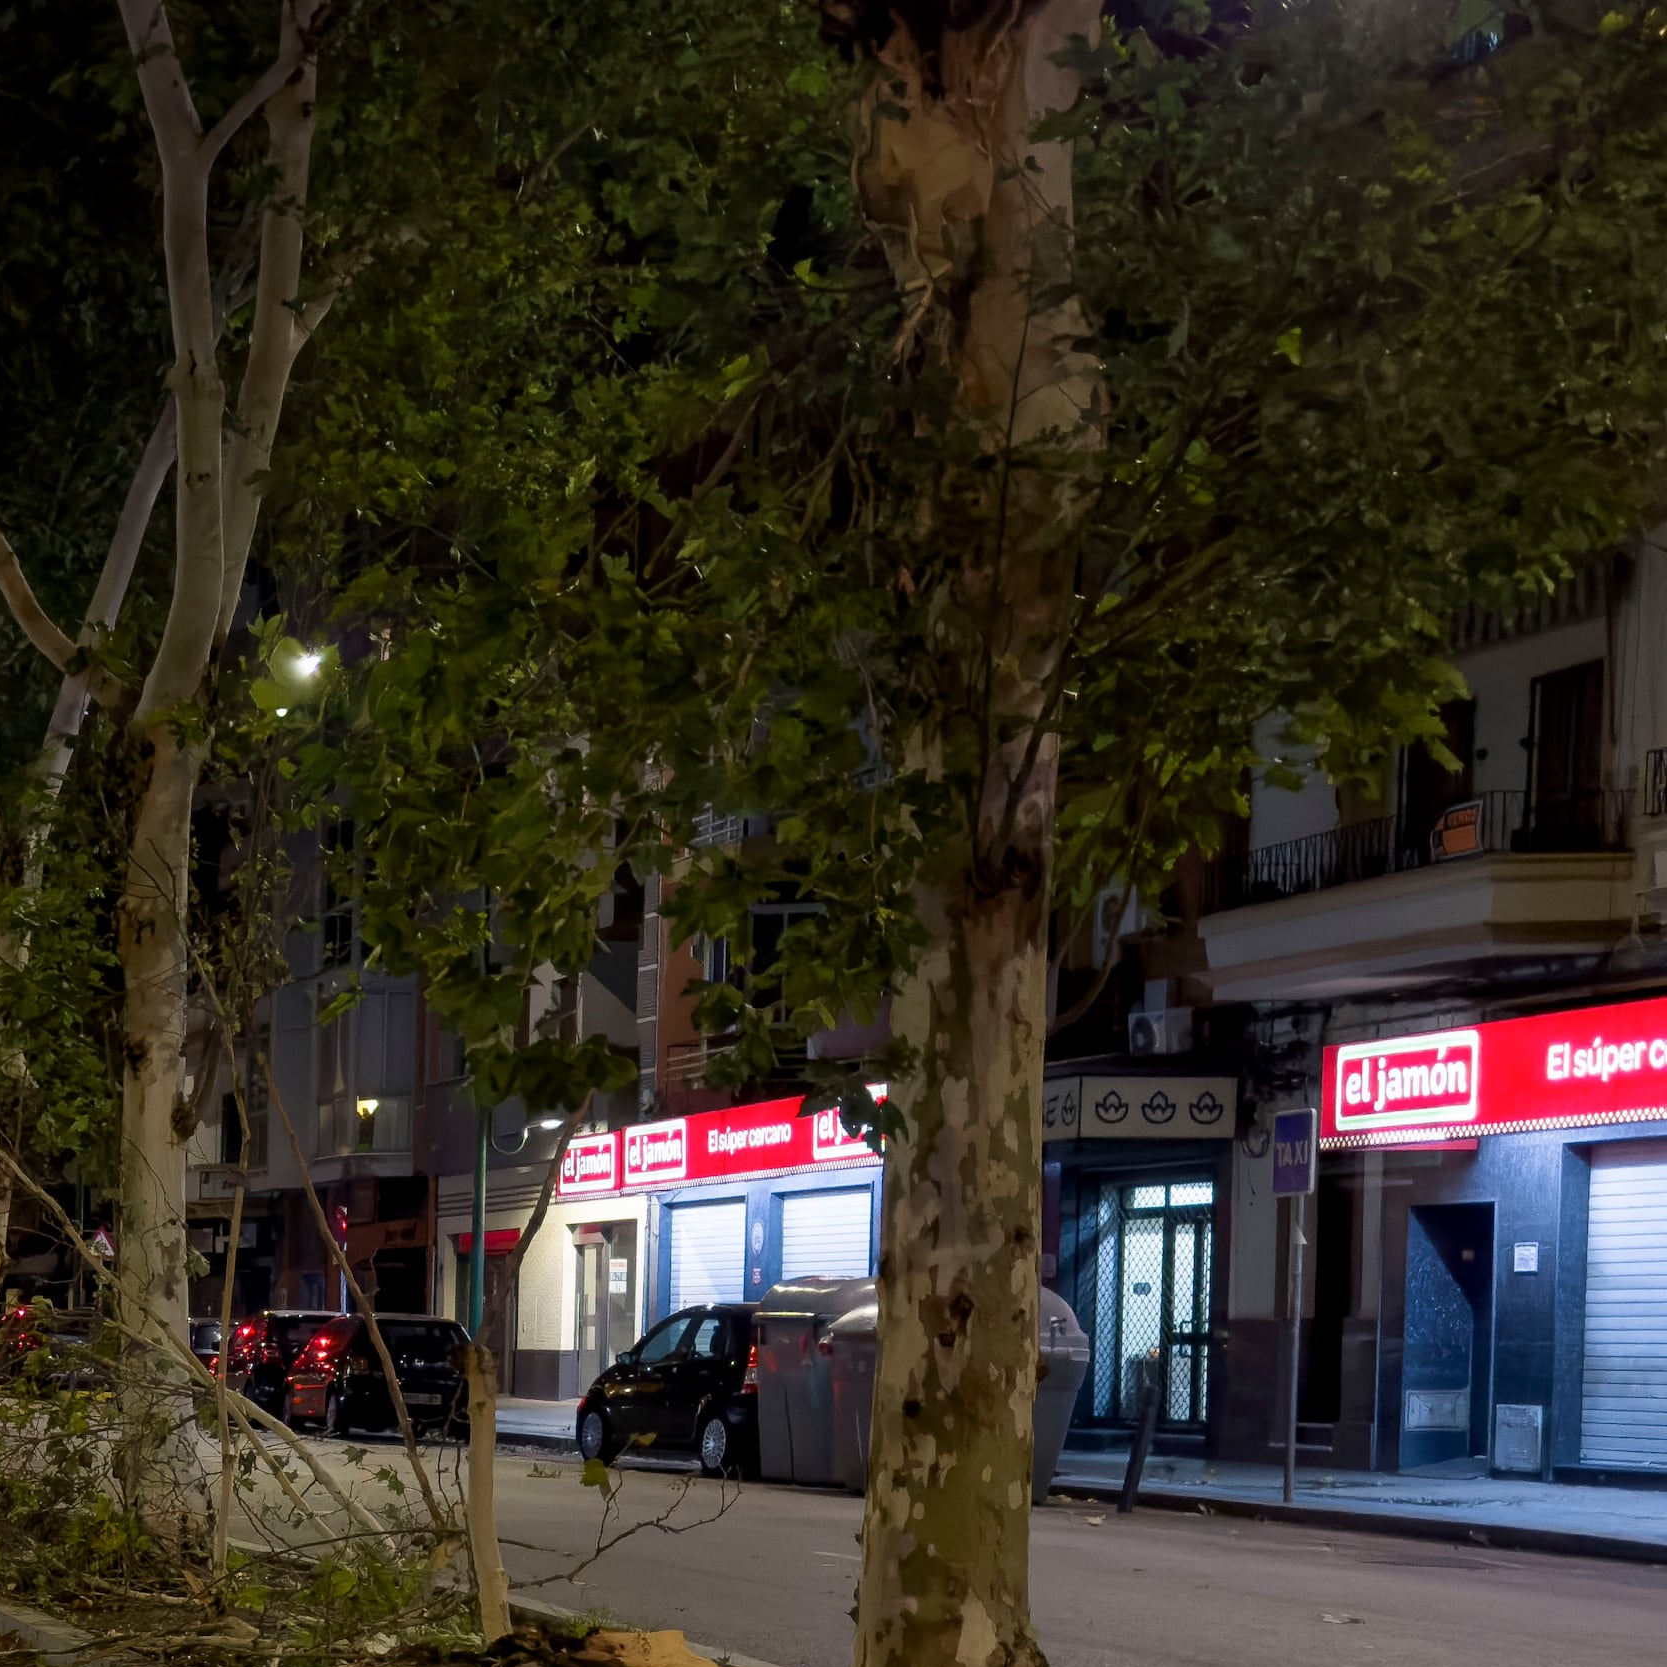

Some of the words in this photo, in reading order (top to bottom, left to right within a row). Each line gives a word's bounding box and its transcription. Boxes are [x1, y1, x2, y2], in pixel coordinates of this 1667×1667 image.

[1546, 1043, 1570, 1081] El
[1572, 1036, 1647, 1082] súper
[1345, 1058, 1370, 1104] el
[1374, 1046, 1467, 1112] jamón
[707, 1130, 719, 1153] El
[718, 1126, 749, 1155] súper
[749, 1124, 791, 1149] cercano
[818, 1110, 833, 1140] el
[564, 1151, 575, 1177] el
[575, 1144, 611, 1183] jamón
[629, 1137, 642, 1166] el
[641, 1126, 682, 1172] jamón
[1275, 1140, 1308, 1168] TAXI
